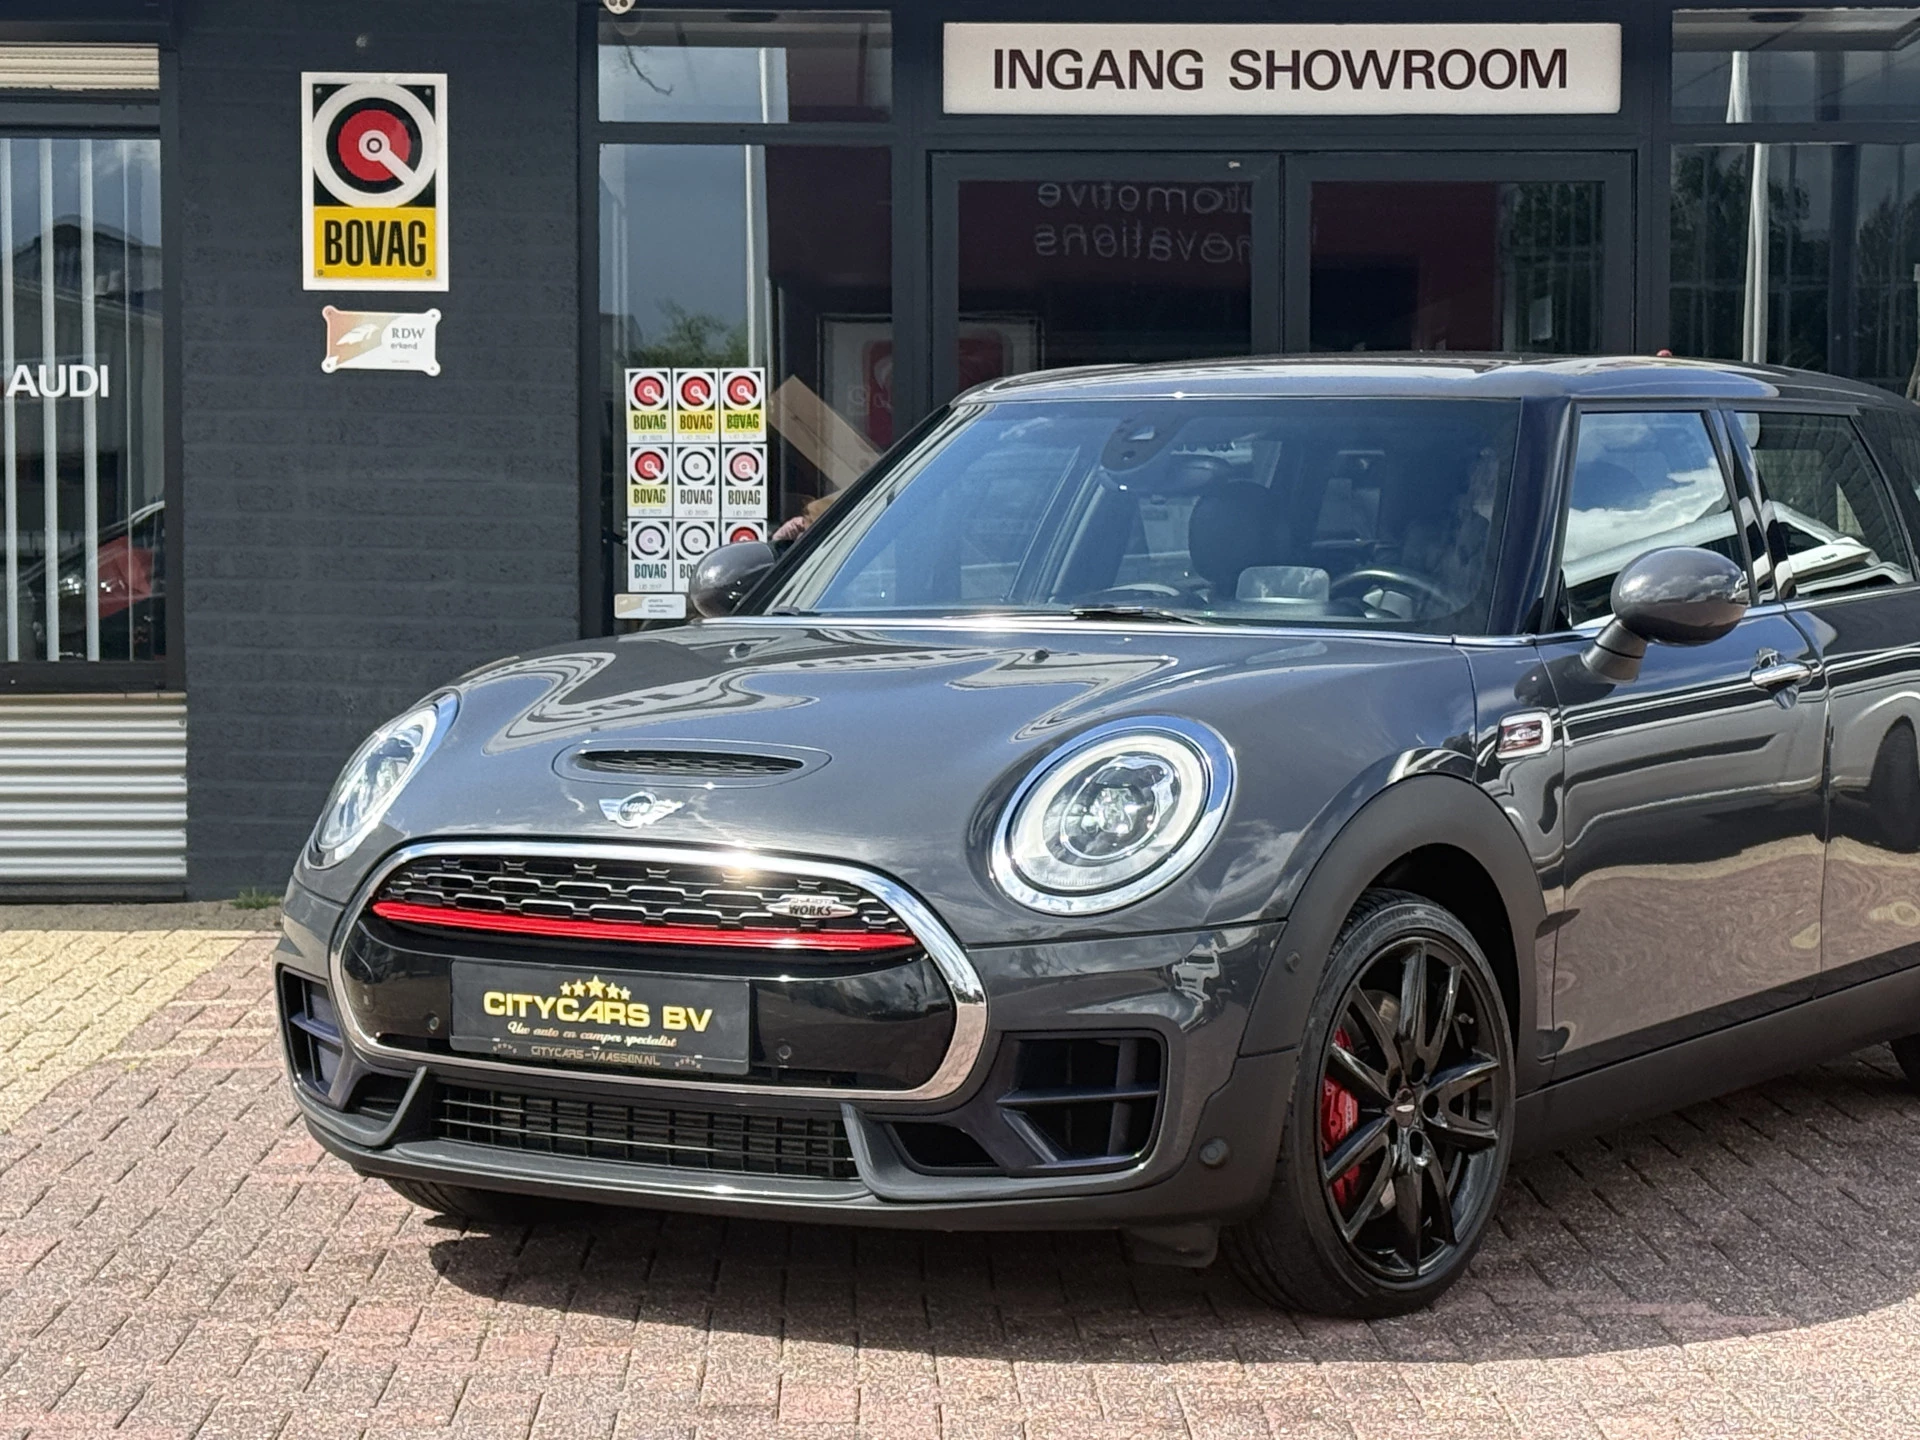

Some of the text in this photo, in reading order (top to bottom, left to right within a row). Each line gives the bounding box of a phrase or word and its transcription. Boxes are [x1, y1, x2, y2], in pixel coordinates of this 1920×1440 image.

[994, 48, 1567, 91] INGANG SHOWROOM
[324, 219, 426, 267] BOVAG
[391, 328, 425, 339] RDW
[5, 364, 109, 398] AUDI
[633, 414, 666, 430] BOVAG
[680, 414, 713, 430] BOVAG
[727, 413, 759, 429] BOVAG
[633, 488, 666, 504] BOVAG
[680, 489, 713, 505] BOVAG
[728, 489, 761, 505] BOVAG
[634, 563, 667, 579] BOVAG
[789, 905, 832, 916] WORKS
[483, 991, 712, 1032] CITYCARS BV
[508, 1021, 677, 1047] Uw auto en camper specialist
